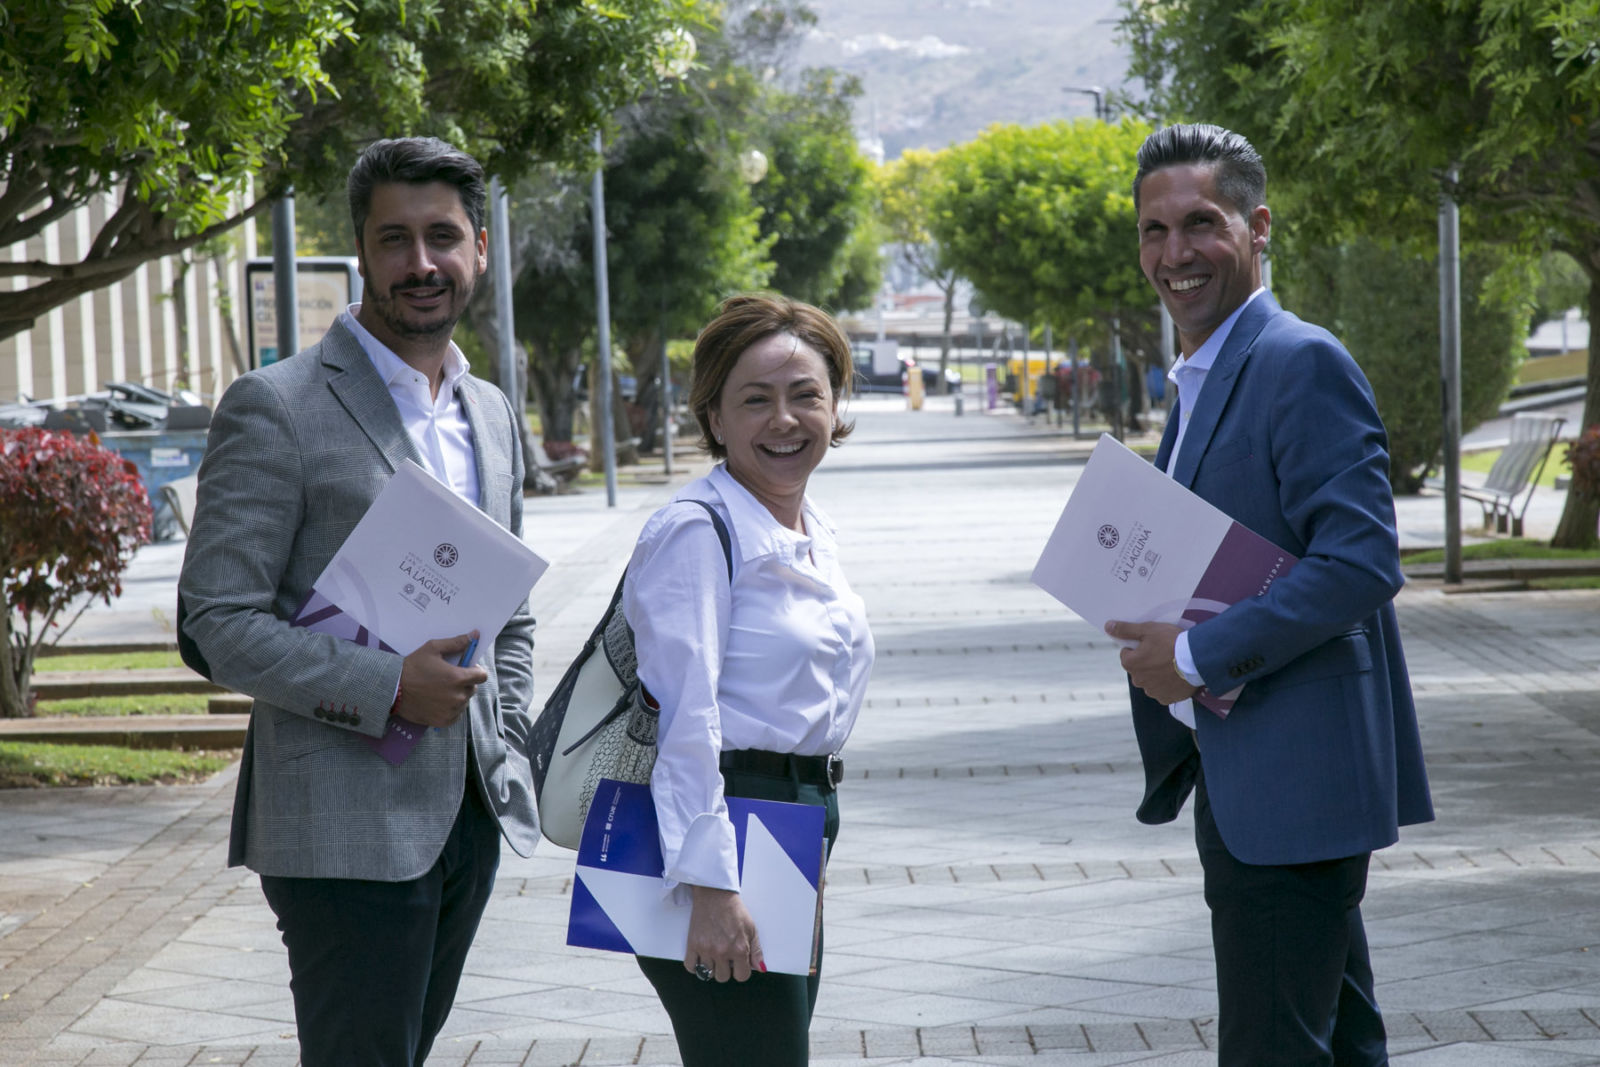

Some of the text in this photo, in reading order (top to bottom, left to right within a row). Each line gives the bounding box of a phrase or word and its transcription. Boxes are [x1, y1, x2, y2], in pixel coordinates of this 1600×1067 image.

[1119, 569, 1131, 582] LA
[1126, 529, 1152, 569] LAGUNA
[399, 560, 412, 576] LA
[412, 570, 451, 606] LAGUNA
